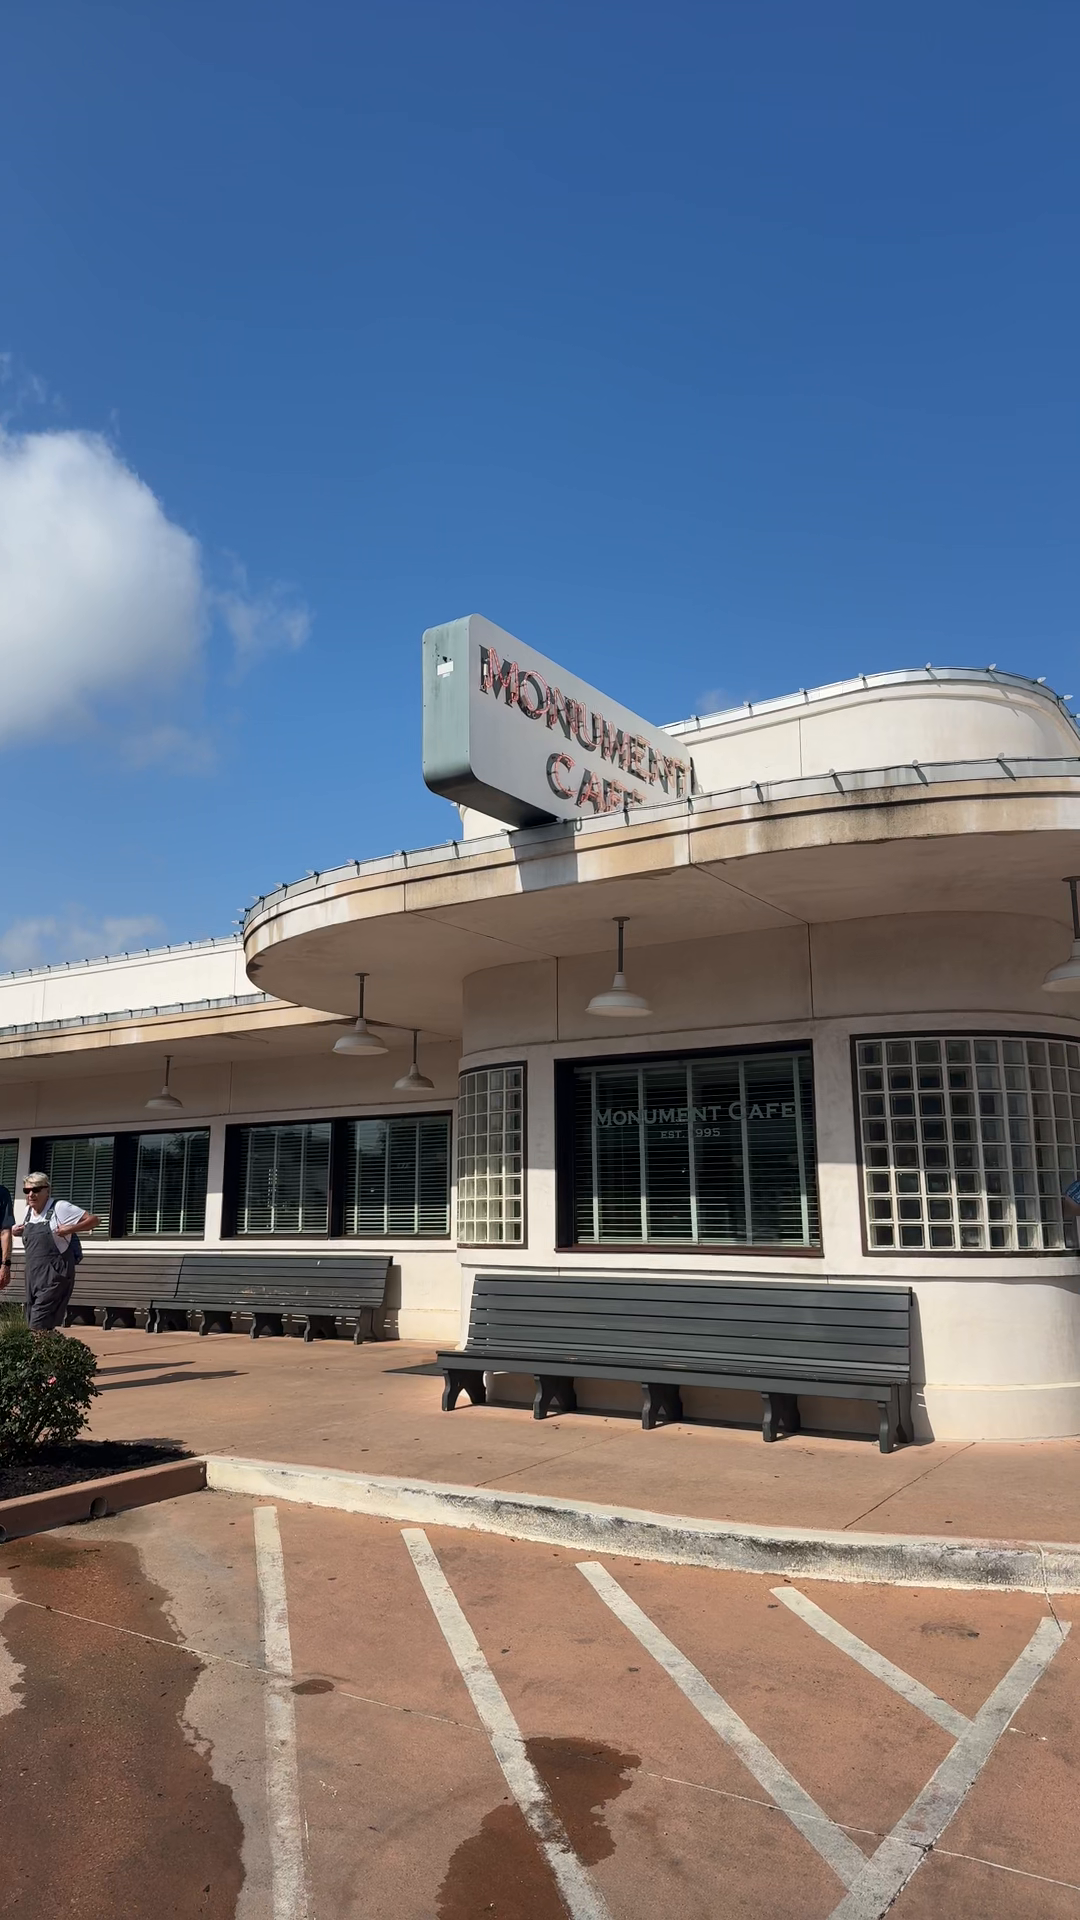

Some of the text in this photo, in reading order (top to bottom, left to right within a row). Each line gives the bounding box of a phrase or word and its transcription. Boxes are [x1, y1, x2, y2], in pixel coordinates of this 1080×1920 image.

[479, 644, 692, 799] MONUMENT
[594, 1101, 797, 1127] MONUMENT CAFE
[660, 1127, 721, 1139] EST. 995
